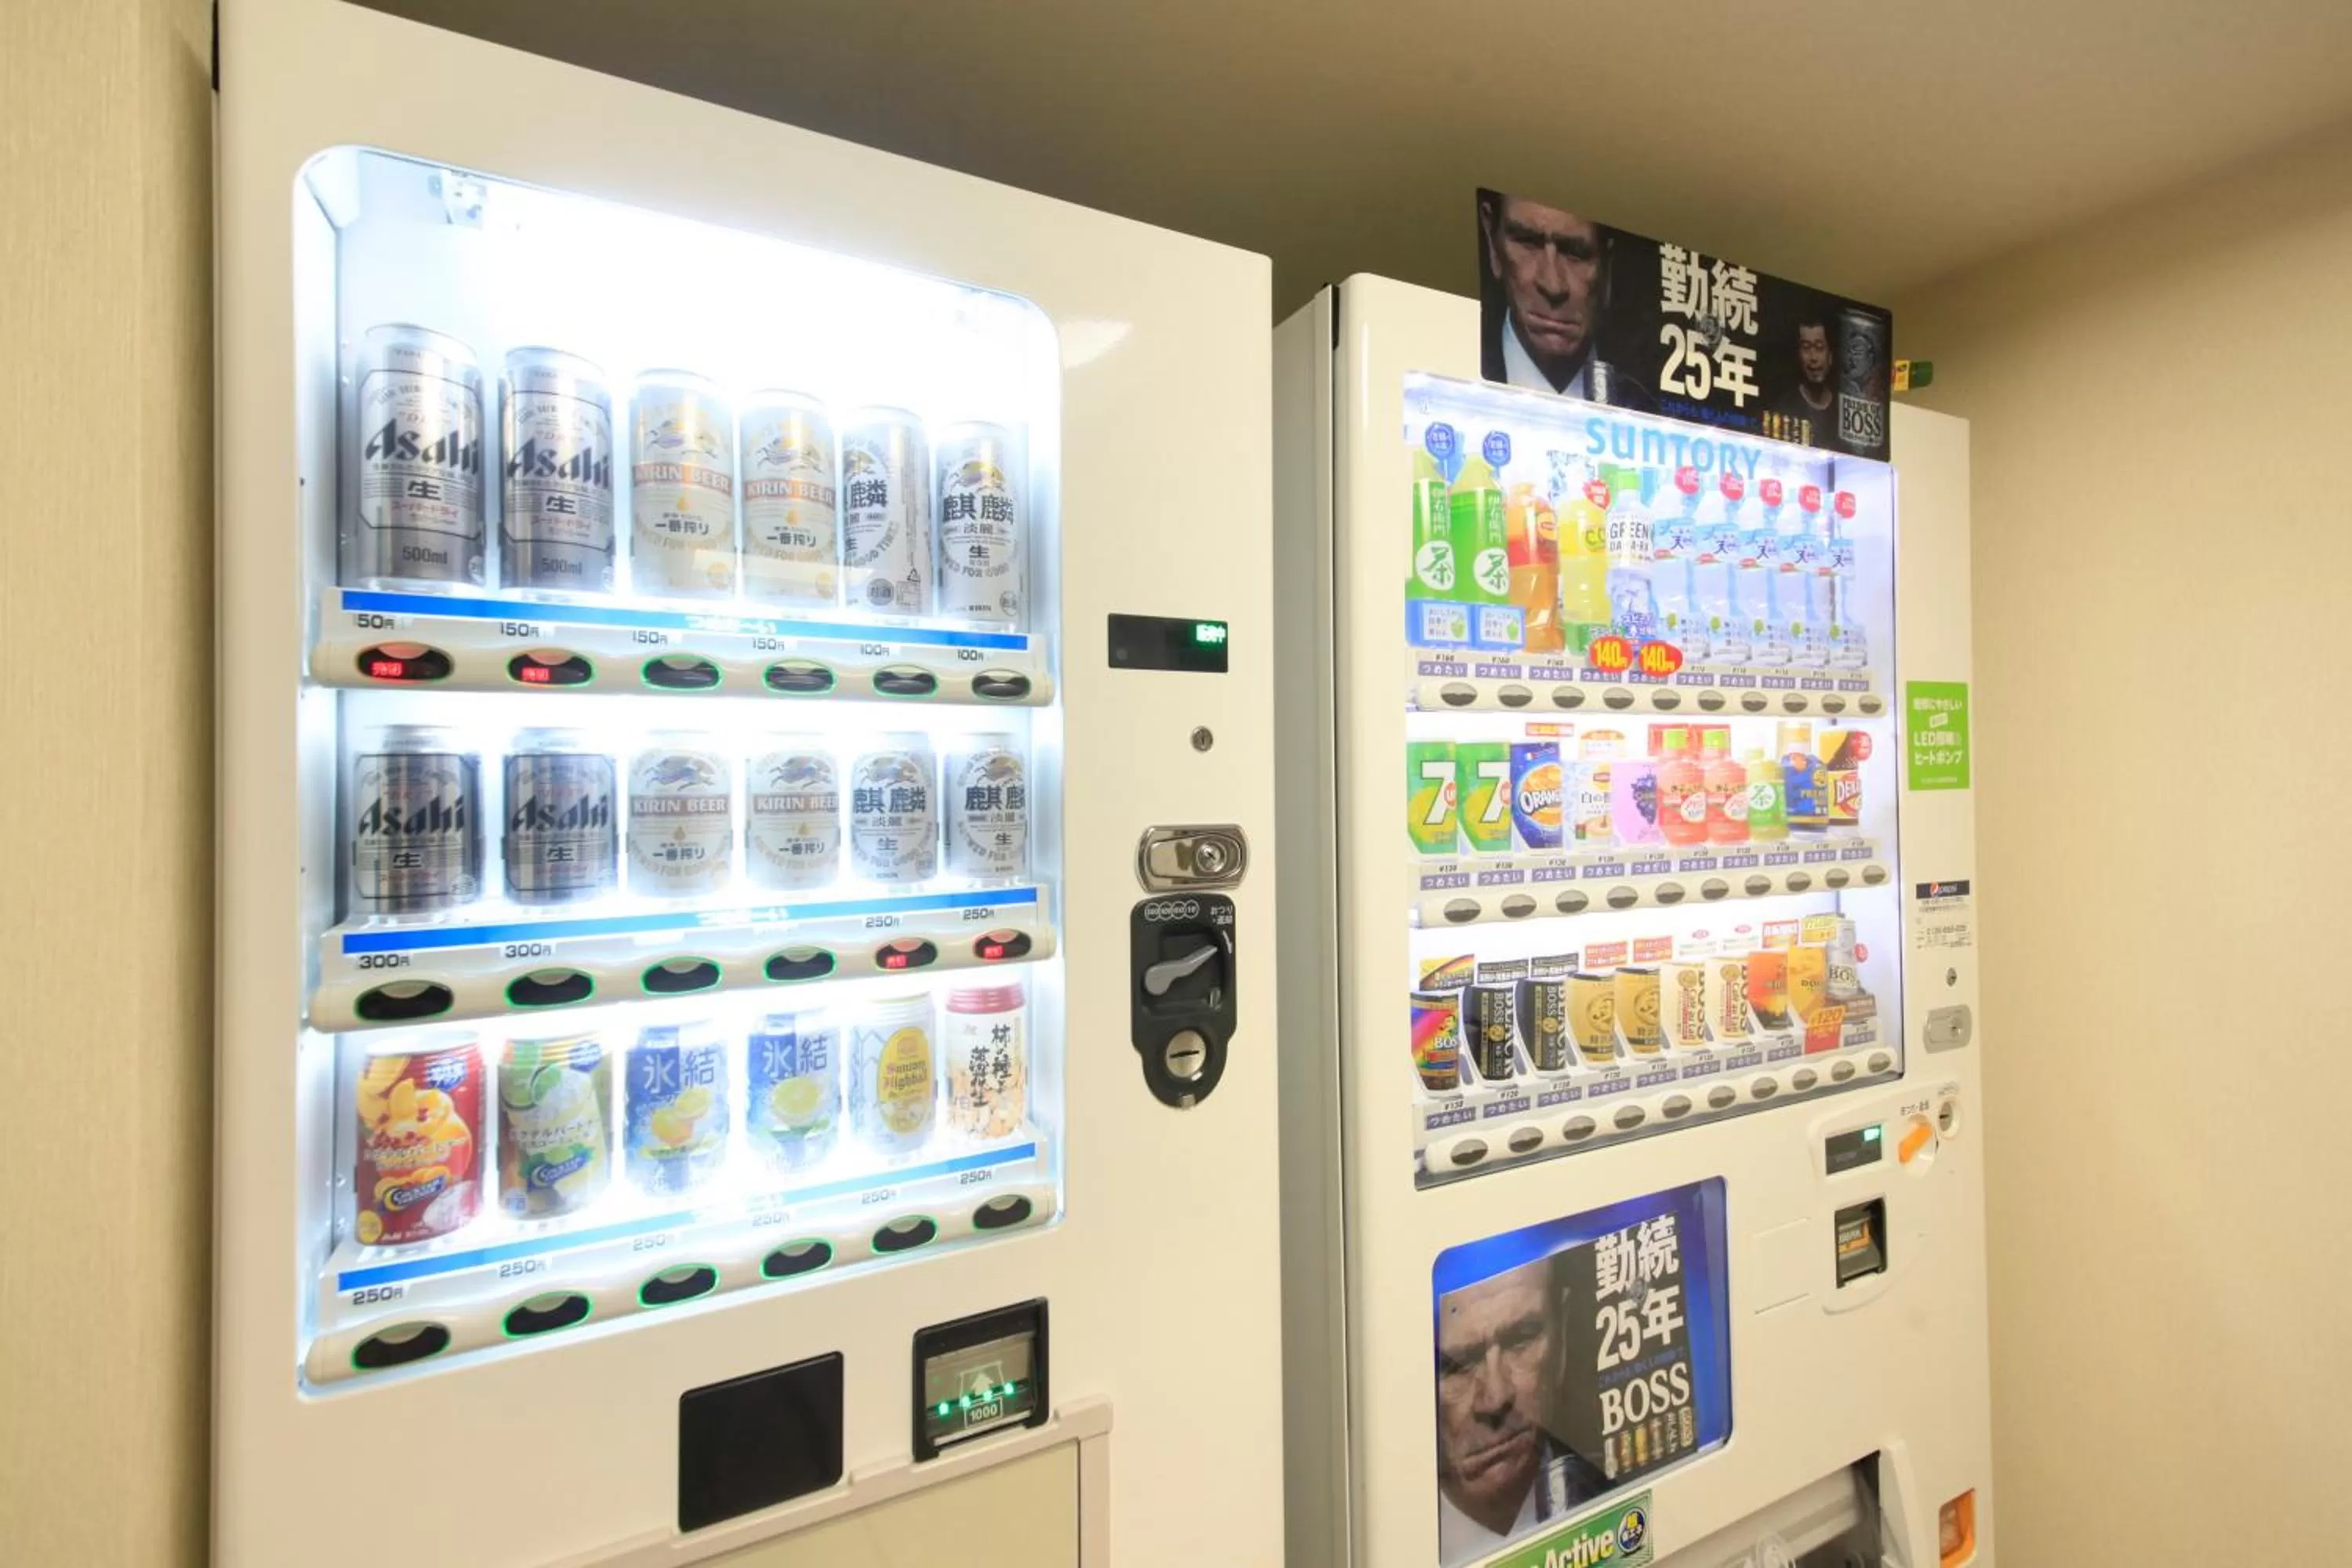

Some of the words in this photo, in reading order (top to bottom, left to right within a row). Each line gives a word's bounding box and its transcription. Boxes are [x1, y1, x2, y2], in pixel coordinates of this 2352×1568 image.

[1659, 242, 1759, 336] 勤続
[1659, 323, 1760, 408] 25年
[1842, 407, 1882, 437] BOSS
[365, 418, 480, 475] Asahi
[506, 438, 610, 490] Asahi
[692, 470, 730, 492] BEER
[408, 480, 441, 502] 生
[746, 481, 794, 498] KIRIN
[800, 485, 834, 506] BEER
[546, 495, 577, 515] 生
[942, 492, 1014, 524] 麒麟
[655, 520, 710, 535] 一番搾り
[767, 532, 817, 548] 一番搾り
[402, 546, 448, 565] 500ml
[968, 545, 990, 559] 生
[541, 557, 584, 575] 500ml
[1421, 546, 1454, 586] 茶
[1481, 554, 1507, 590] 茶
[1421, 663, 1465, 676] つめたい
[1479, 666, 1519, 677] つめたい
[1533, 669, 1570, 679] つめたい
[853, 786, 927, 815] 麒麟
[1421, 760, 1456, 826] 7
[1477, 760, 1511, 824] 7
[633, 799, 681, 813] KIRIN
[686, 797, 728, 812] BEER
[757, 796, 805, 811] KIRIN
[358, 795, 464, 836] Asahi
[512, 794, 608, 833] Asahi
[877, 837, 898, 851] 生
[995, 833, 1013, 845] 生
[546, 847, 575, 863] 生
[652, 845, 706, 861] 一番搾り
[779, 841, 826, 856] 一番搾り
[393, 852, 422, 869] 生
[1632, 862, 1668, 874] つめたい
[1481, 873, 1521, 884] つめたい
[1535, 869, 1573, 880] つめたい
[1585, 865, 1622, 876] つめたい
[1425, 876, 1466, 887] つめたい
[505, 943, 551, 958] 300円
[358, 953, 410, 969] 300円
[1494, 992, 1504, 1024] BOSS
[1546, 985, 1558, 1017] BOSS
[762, 1033, 829, 1077] 氷結
[643, 1047, 717, 1094] 氷結
[1591, 1080, 1629, 1094] つめたい
[1541, 1090, 1581, 1103] つめたい
[1486, 1101, 1529, 1115] つめたい
[1429, 1111, 1473, 1127] つめたい
[1594, 1214, 1679, 1301] 勤続
[499, 1259, 546, 1277] 250円
[352, 1286, 404, 1306] 250円
[1596, 1286, 1684, 1371] 25年
[1599, 1362, 1690, 1436] BOSS
[971, 1404, 998, 1422] 1000
[1544, 1530, 1616, 1568] Active
